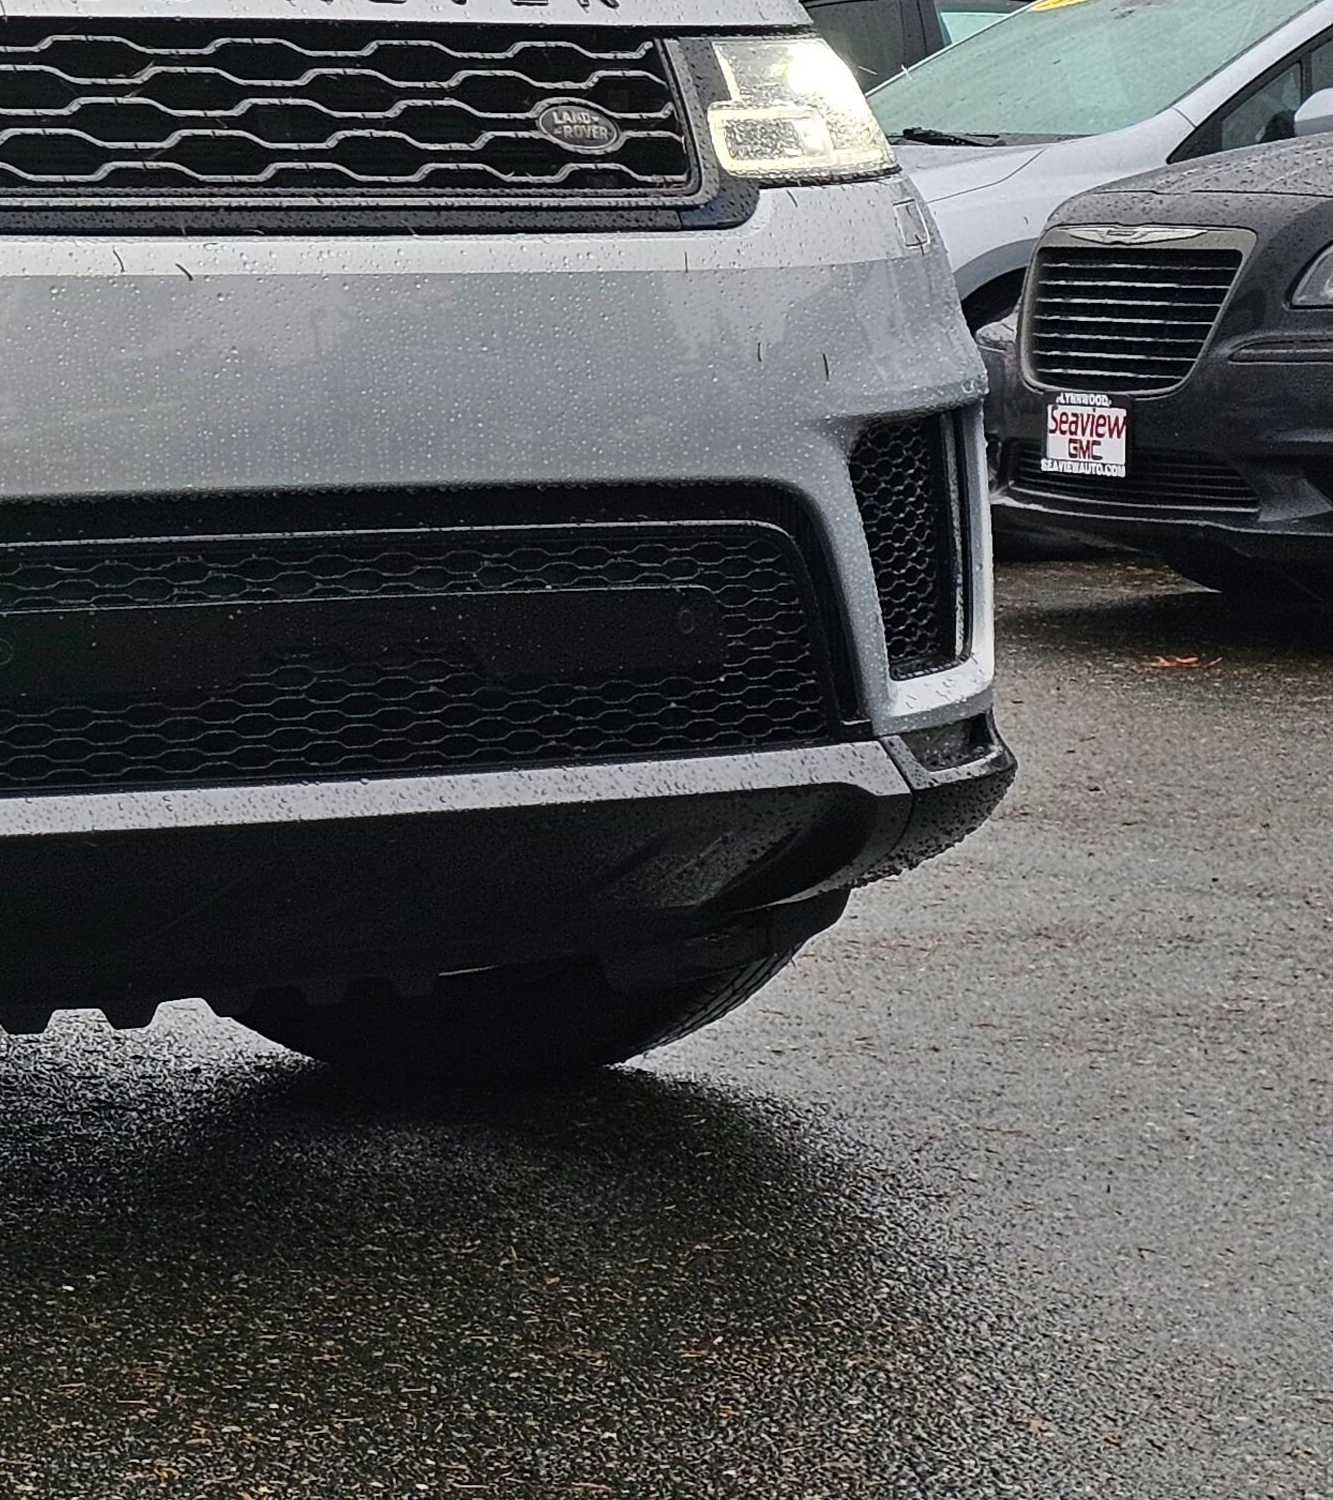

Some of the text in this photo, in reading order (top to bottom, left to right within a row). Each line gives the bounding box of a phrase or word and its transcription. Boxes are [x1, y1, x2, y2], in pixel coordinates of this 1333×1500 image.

[552, 111, 609, 140] LAND ROVER
[1049, 406, 1127, 439] Seaview
[1068, 437, 1103, 461] GMC
